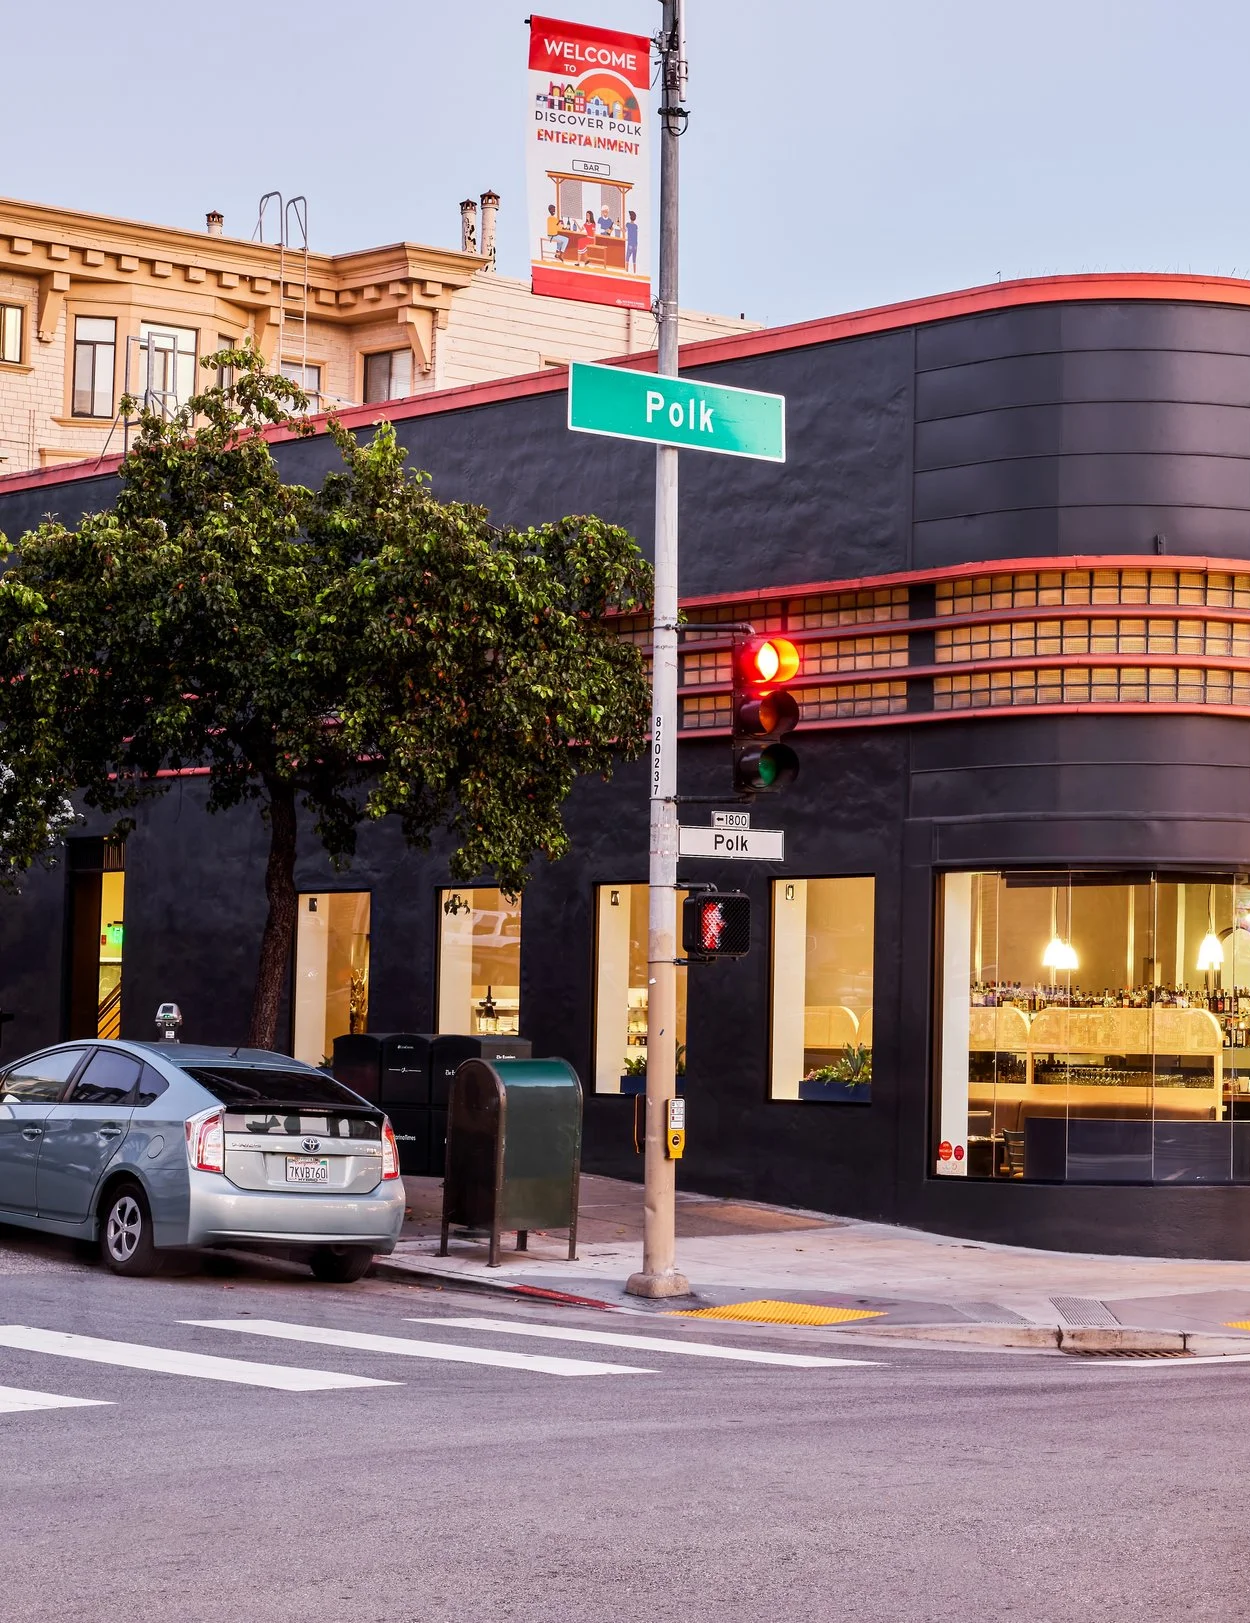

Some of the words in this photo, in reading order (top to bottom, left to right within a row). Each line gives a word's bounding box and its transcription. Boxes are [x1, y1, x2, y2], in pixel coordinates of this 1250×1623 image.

[543, 38, 637, 71] WELCOME
[563, 63, 577, 73] TO
[535, 110, 604, 129] DISCOVER
[609, 121, 642, 137] POLK
[537, 128, 640, 156] ENTERTAINMENT
[583, 163, 600, 172] BAR
[646, 390, 714, 433] Polk
[653, 716, 662, 796] 820237
[725, 814, 747, 826] 1800
[714, 834, 749, 852] Polk
[289, 1165, 326, 1179] 7KVB760
